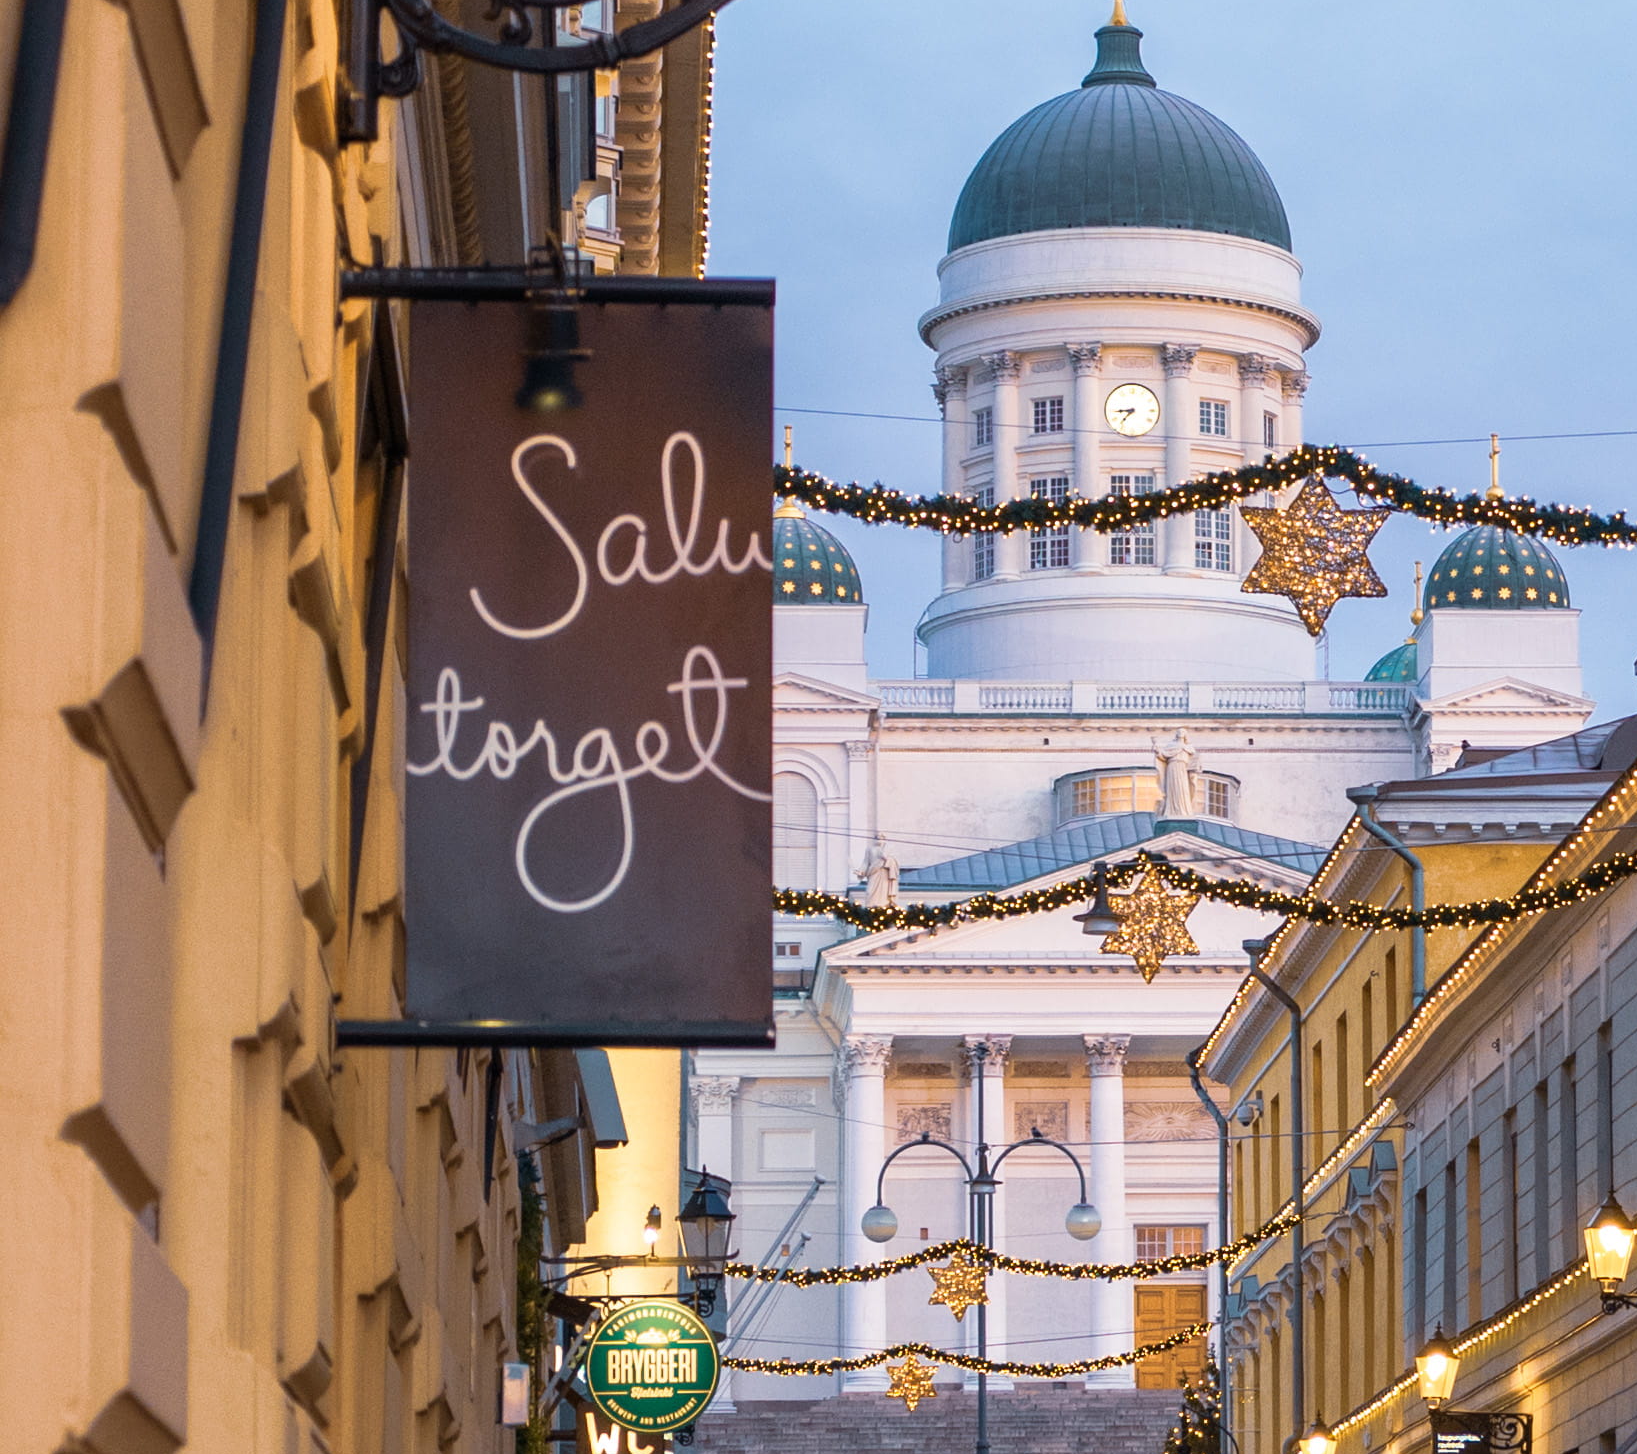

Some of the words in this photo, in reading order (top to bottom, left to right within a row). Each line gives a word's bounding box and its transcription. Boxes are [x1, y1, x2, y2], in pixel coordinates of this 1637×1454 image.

[470, 431, 773, 639] Salu
[407, 646, 773, 911] torget
[607, 1398, 637, 1422] BREWERY
[640, 1417, 654, 1425] AND
[608, 1348, 698, 1384] BRYGGERI
